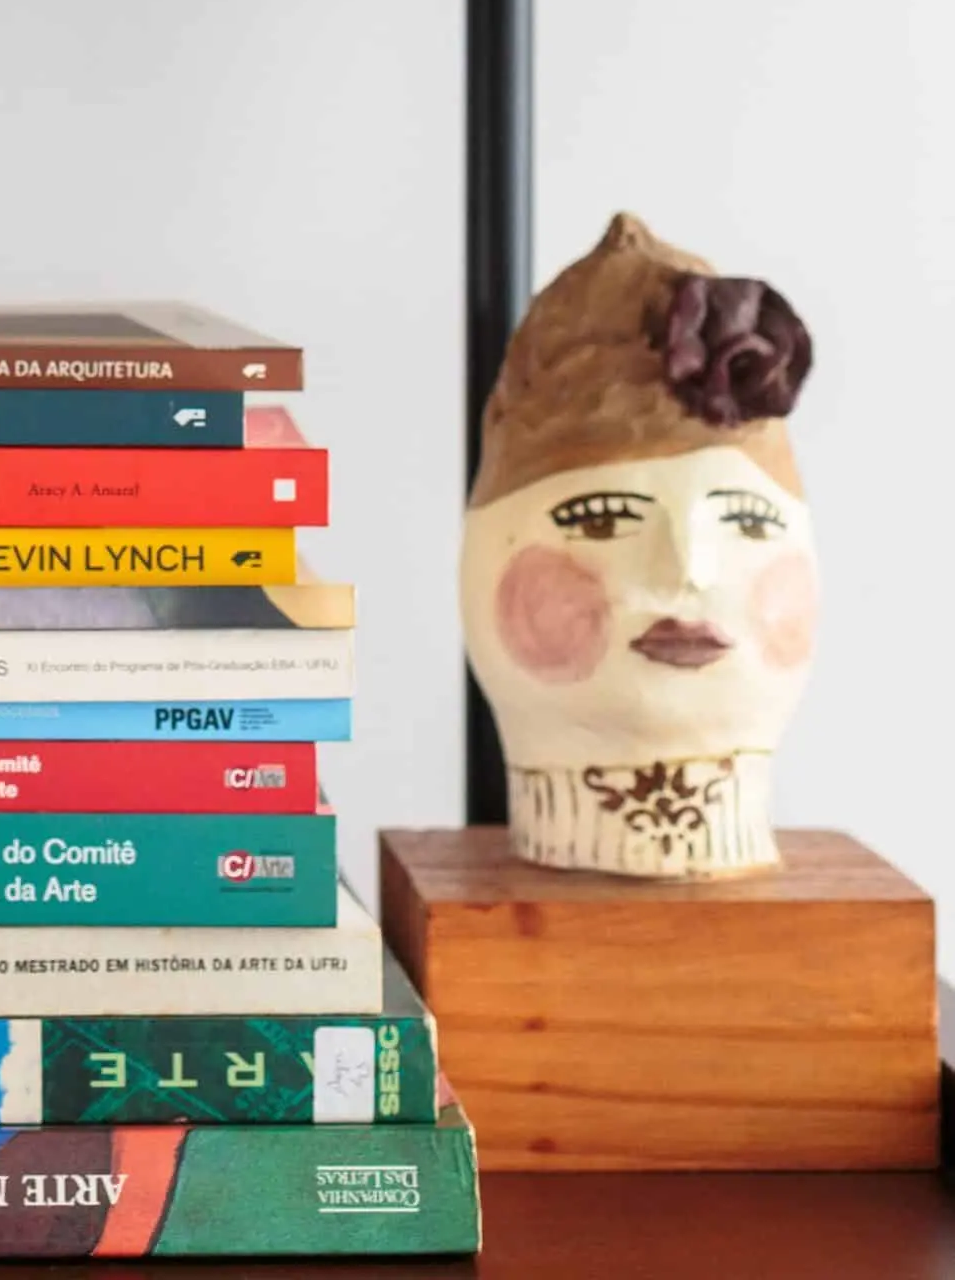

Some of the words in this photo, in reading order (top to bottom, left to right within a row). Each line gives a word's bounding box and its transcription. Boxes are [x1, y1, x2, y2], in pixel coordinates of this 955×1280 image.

[15, 359, 41, 376] DA
[46, 360, 173, 381] ARQUITETURA
[85, 545, 204, 571] LYNCH
[156, 708, 234, 730] PPGAV
[3, 839, 36, 863] do
[43, 838, 136, 864] Comitê
[5, 877, 36, 901] da
[43, 877, 96, 902] Arte
[15, 959, 99, 973] MESTRADO
[107, 959, 129, 972] EM
[135, 956, 206, 972] HISTÓRIA
[213, 958, 232, 972] DA
[240, 958, 277, 971] ARTE
[285, 958, 304, 971] DA
[379, 1023, 400, 1117] SESC
[22, 1171, 130, 1208] ARTE
